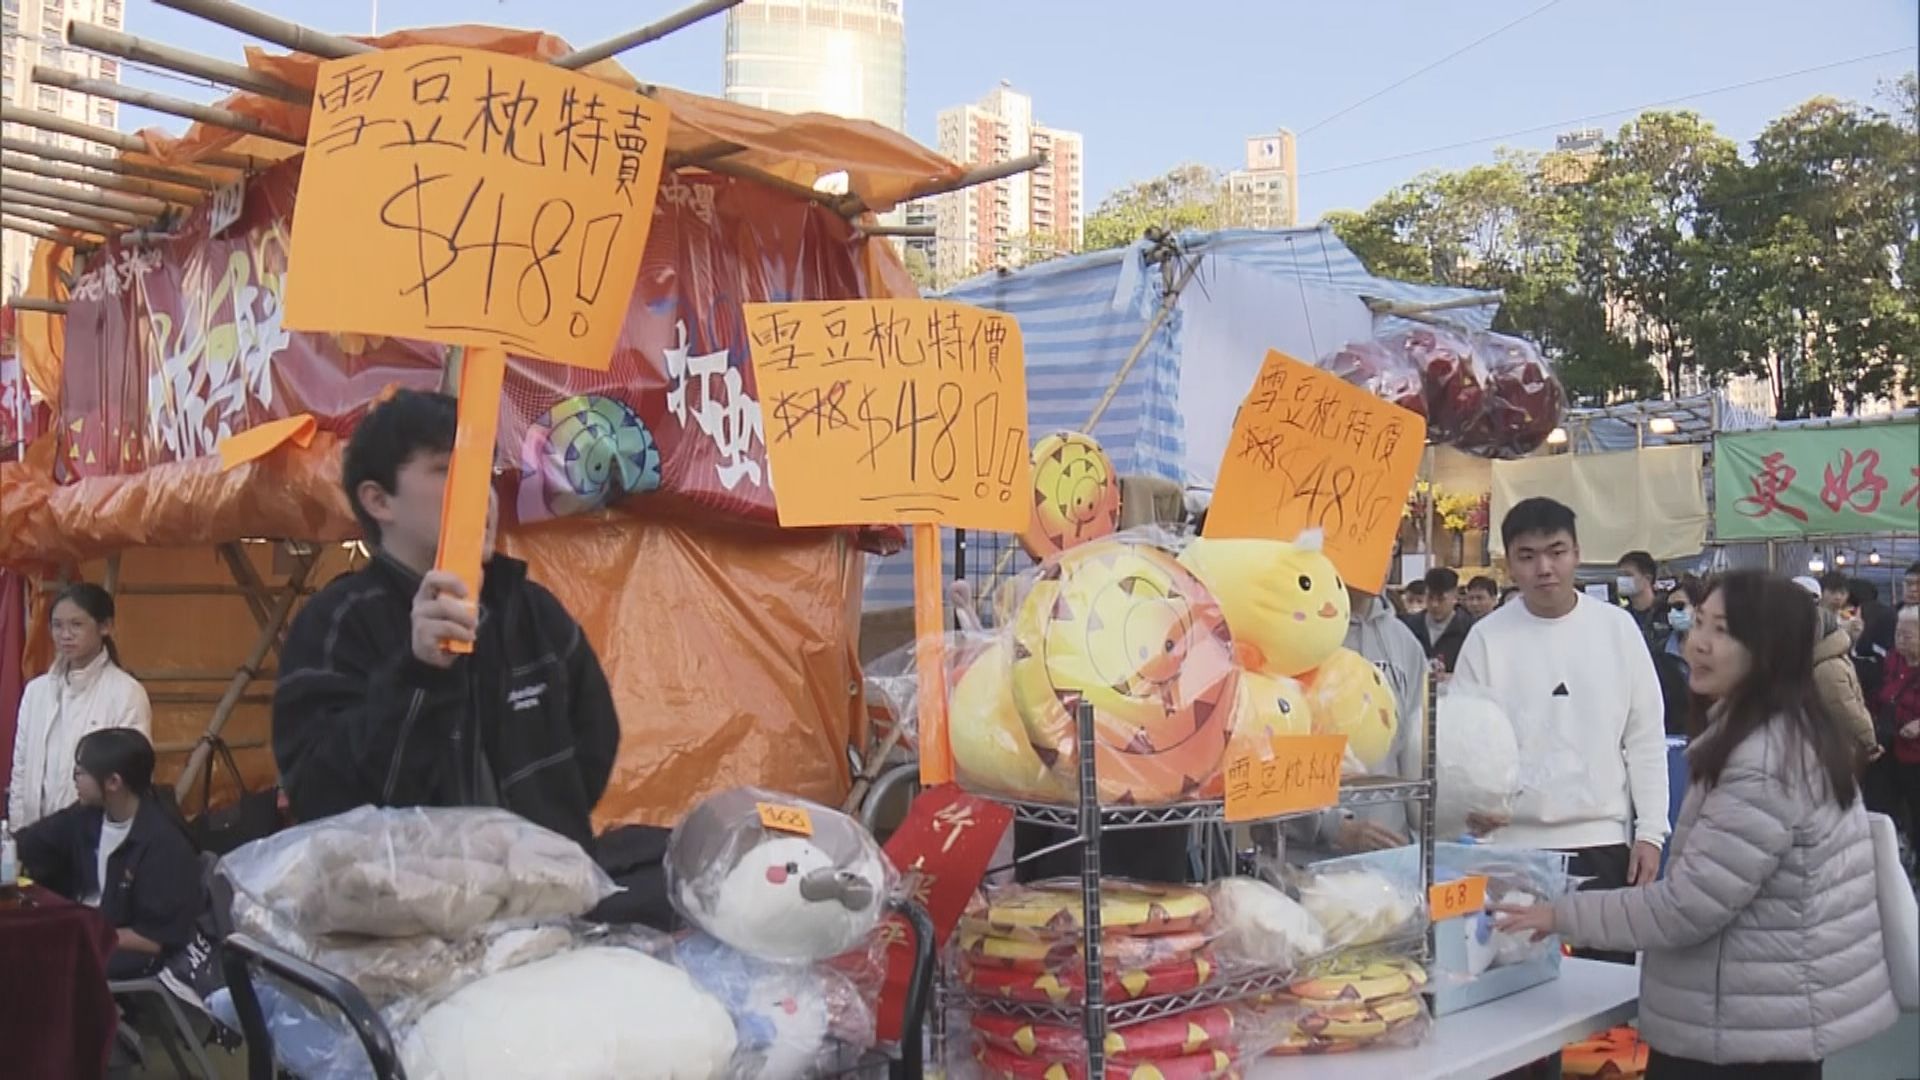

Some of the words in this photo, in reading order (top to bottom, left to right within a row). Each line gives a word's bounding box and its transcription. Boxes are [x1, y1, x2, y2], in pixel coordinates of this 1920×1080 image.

[312, 56, 651, 206] 雪豆枕特賣
[381, 163, 622, 338] $48!
[752, 307, 1008, 382] 雪豆枕特價
[857, 380, 1024, 501] $48!!
[1444, 883, 1468, 910] 68
